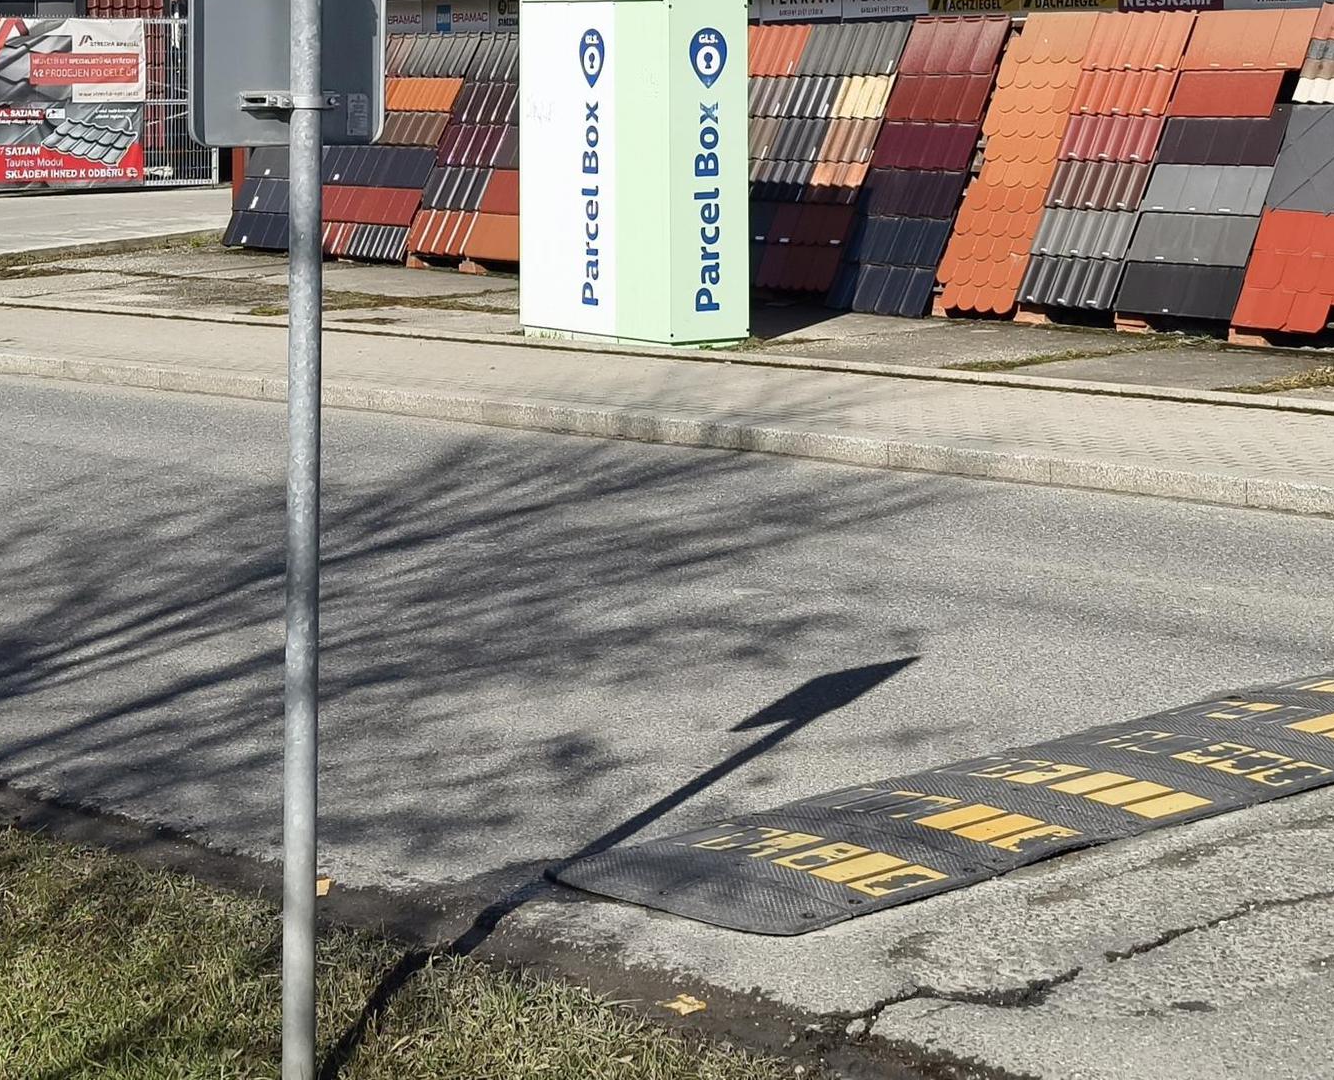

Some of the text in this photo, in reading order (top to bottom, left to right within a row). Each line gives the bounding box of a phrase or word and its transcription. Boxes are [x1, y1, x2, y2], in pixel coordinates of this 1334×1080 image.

[452, 12, 489, 23] BRAMAC
[33, 69, 44, 77] 42
[91, 68, 102, 77] PO
[5, 146, 41, 156] SATJAM
[5, 158, 63, 168] Taurus Modul
[5, 167, 124, 180] SKLADEM IHNED K ODBĚRU
[581, 101, 599, 307] Parcel Box
[694, 102, 720, 312] Parcel Box
